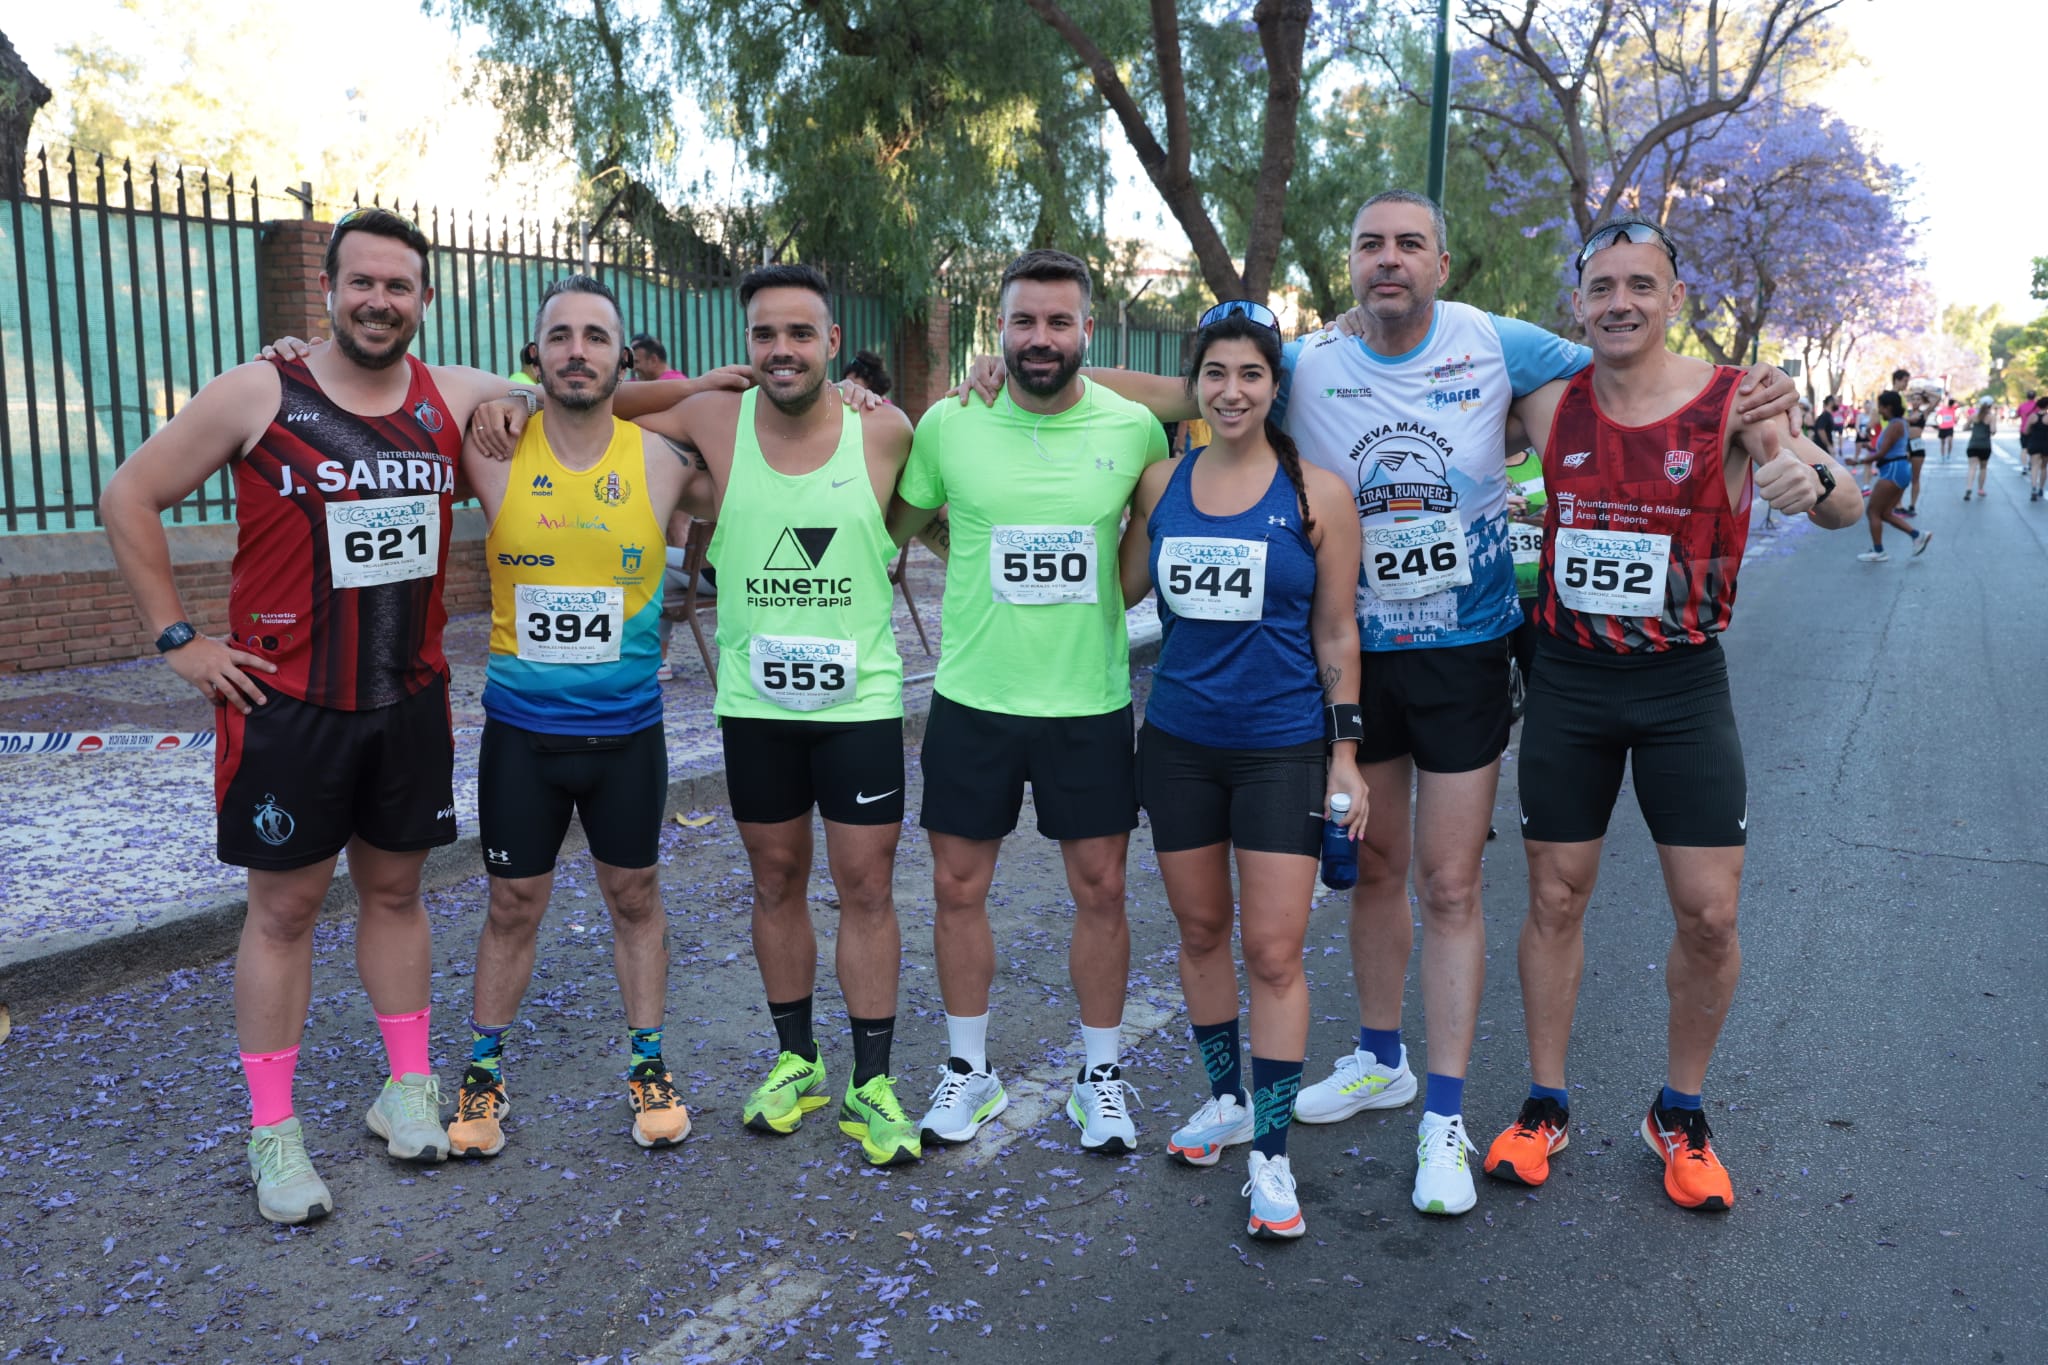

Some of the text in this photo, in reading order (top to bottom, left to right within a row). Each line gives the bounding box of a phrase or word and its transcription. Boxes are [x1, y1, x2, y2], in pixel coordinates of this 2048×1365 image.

[1435, 388, 1480, 404] PLAFER
[1349, 421, 1454, 461] NUEVA MÁLAGA
[376, 451, 453, 464] ENTRENAMIENTOS
[279, 459, 455, 497] J. SARRIA
[1395, 485, 1449, 499] RUNNERS
[1576, 499, 1692, 517] Ayuntamiento de Málaga
[1576, 511, 1648, 525] Área de Deporte
[345, 525, 426, 563] 621
[497, 553, 556, 566] EVOS
[1003, 552, 1087, 582] 550
[1374, 541, 1457, 580] 246
[1169, 565, 1252, 598] 544
[1565, 557, 1653, 594] 552
[528, 612, 611, 643] 394
[763, 662, 845, 691] 553
